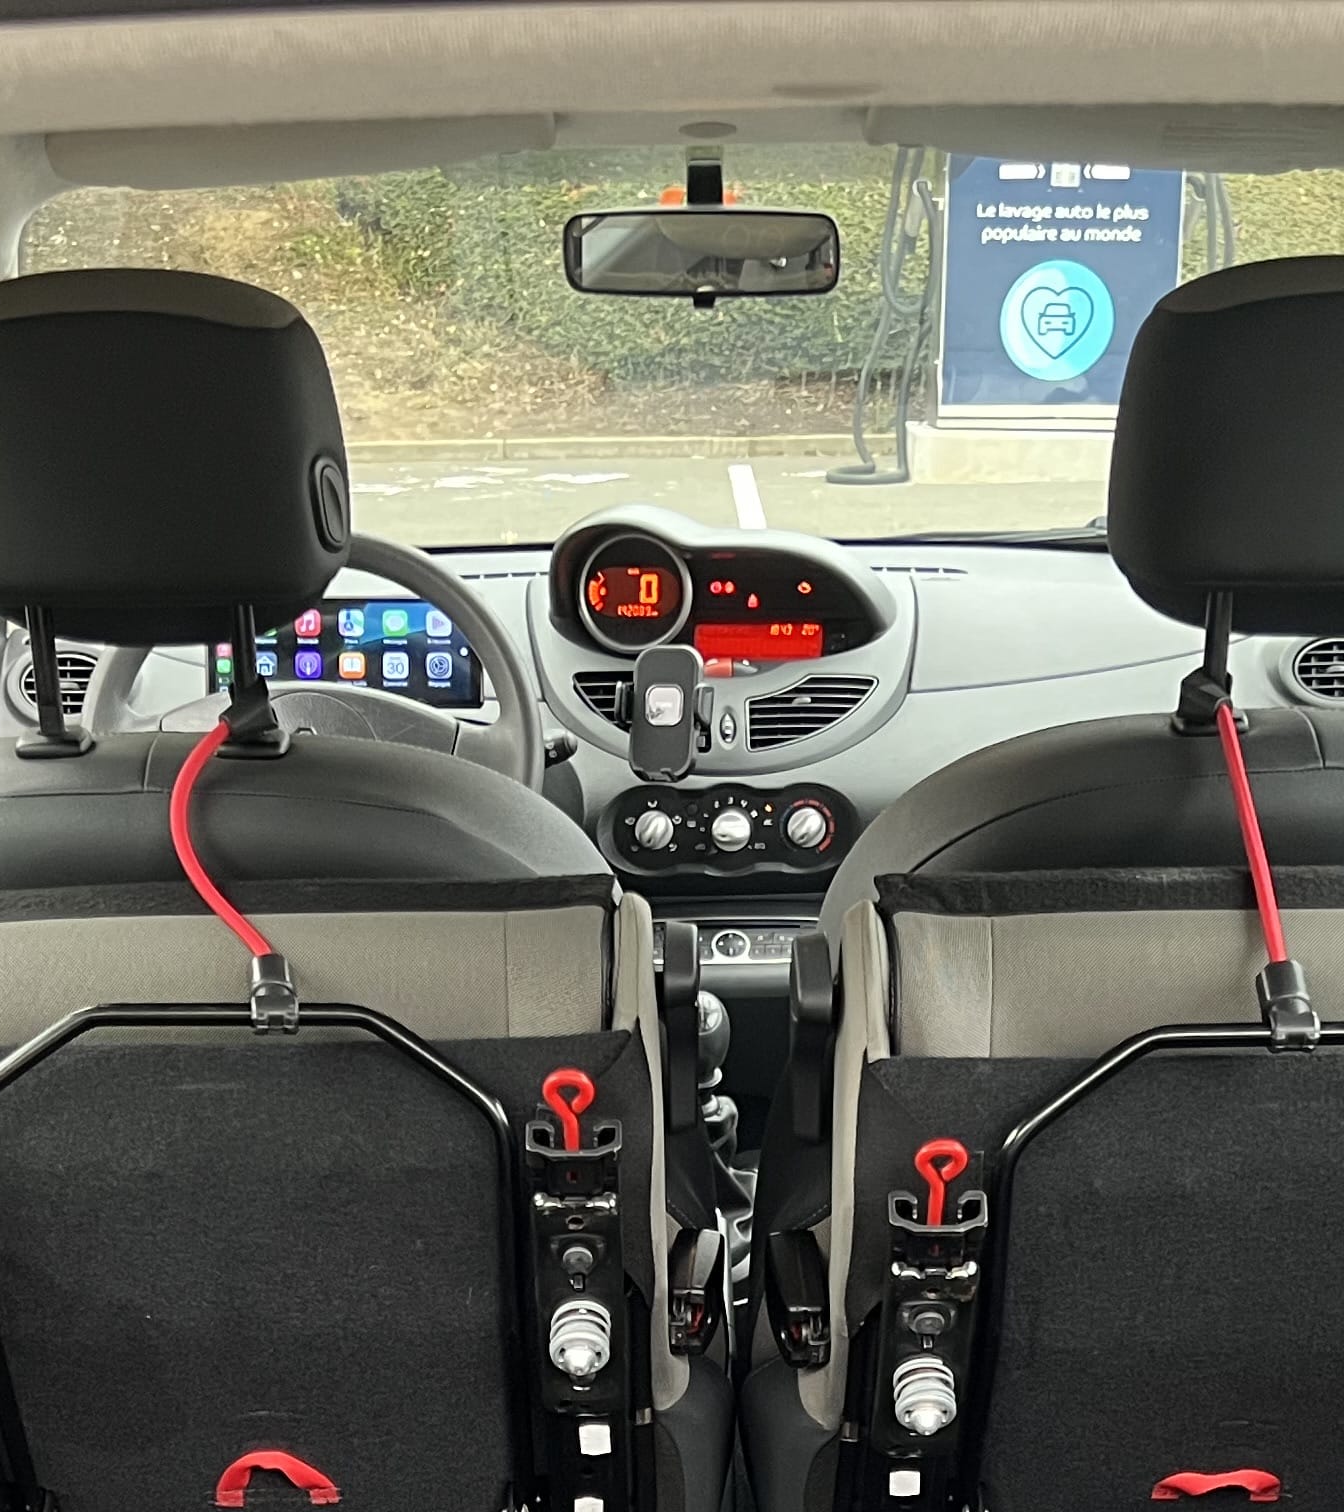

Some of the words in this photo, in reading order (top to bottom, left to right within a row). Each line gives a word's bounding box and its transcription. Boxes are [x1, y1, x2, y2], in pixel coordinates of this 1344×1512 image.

[976, 203, 996, 218] Le
[998, 202, 1052, 222] lavage
[1054, 205, 1094, 220] auto
[1096, 203, 1111, 219] le
[1112, 203, 1149, 223] plus
[981, 224, 1057, 244] populaire
[1059, 227, 1082, 242] au
[1084, 225, 1142, 242] monde
[639, 573, 659, 604] 0
[386, 662, 405, 675] 30
